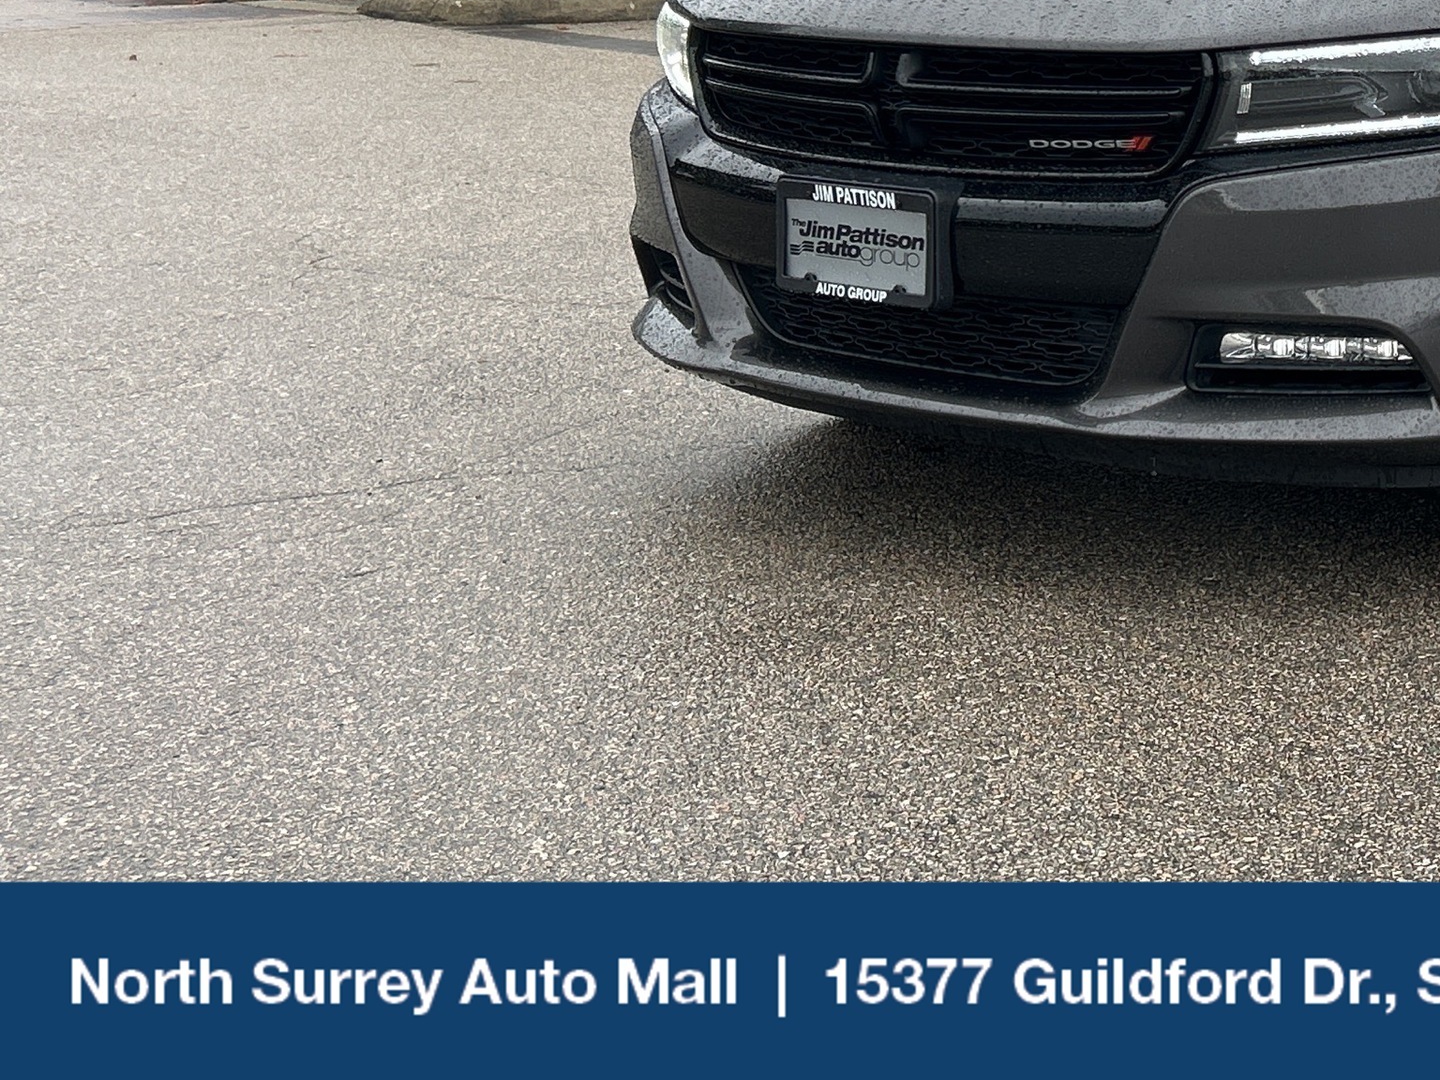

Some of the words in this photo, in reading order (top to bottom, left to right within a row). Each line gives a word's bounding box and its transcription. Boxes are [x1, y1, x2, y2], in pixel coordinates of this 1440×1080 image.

[1029, 139, 1137, 149] DODGE
[812, 184, 834, 203] JIM
[836, 187, 896, 209] PATTISON
[815, 281, 845, 298] AUTO
[847, 286, 888, 303] GROUP
